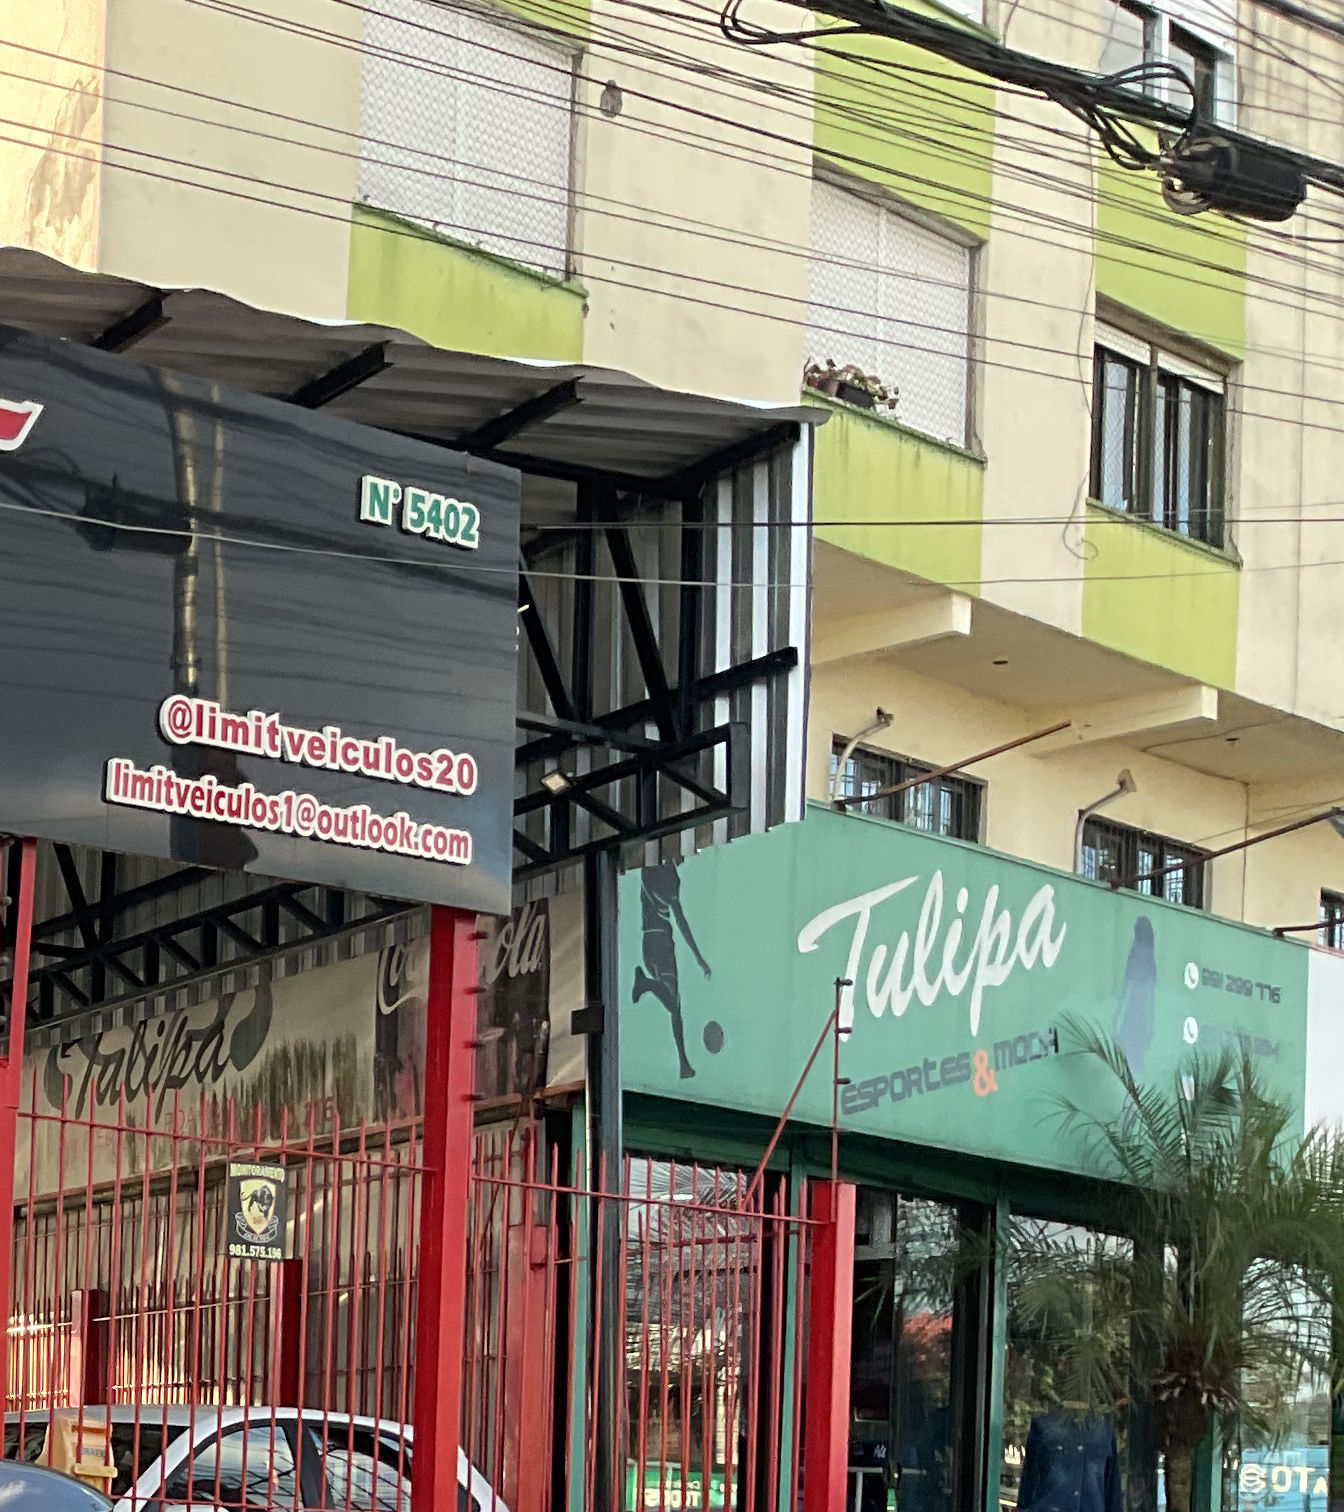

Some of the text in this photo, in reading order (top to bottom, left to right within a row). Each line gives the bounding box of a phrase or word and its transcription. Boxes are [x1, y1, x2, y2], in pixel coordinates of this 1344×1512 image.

[402, 487, 480, 549] 5402
[161, 695, 477, 795] @limitveiculos20
[107, 758, 472, 865] limitveiculos1@outlook.com
[798, 869, 1067, 1042] Tulipa
